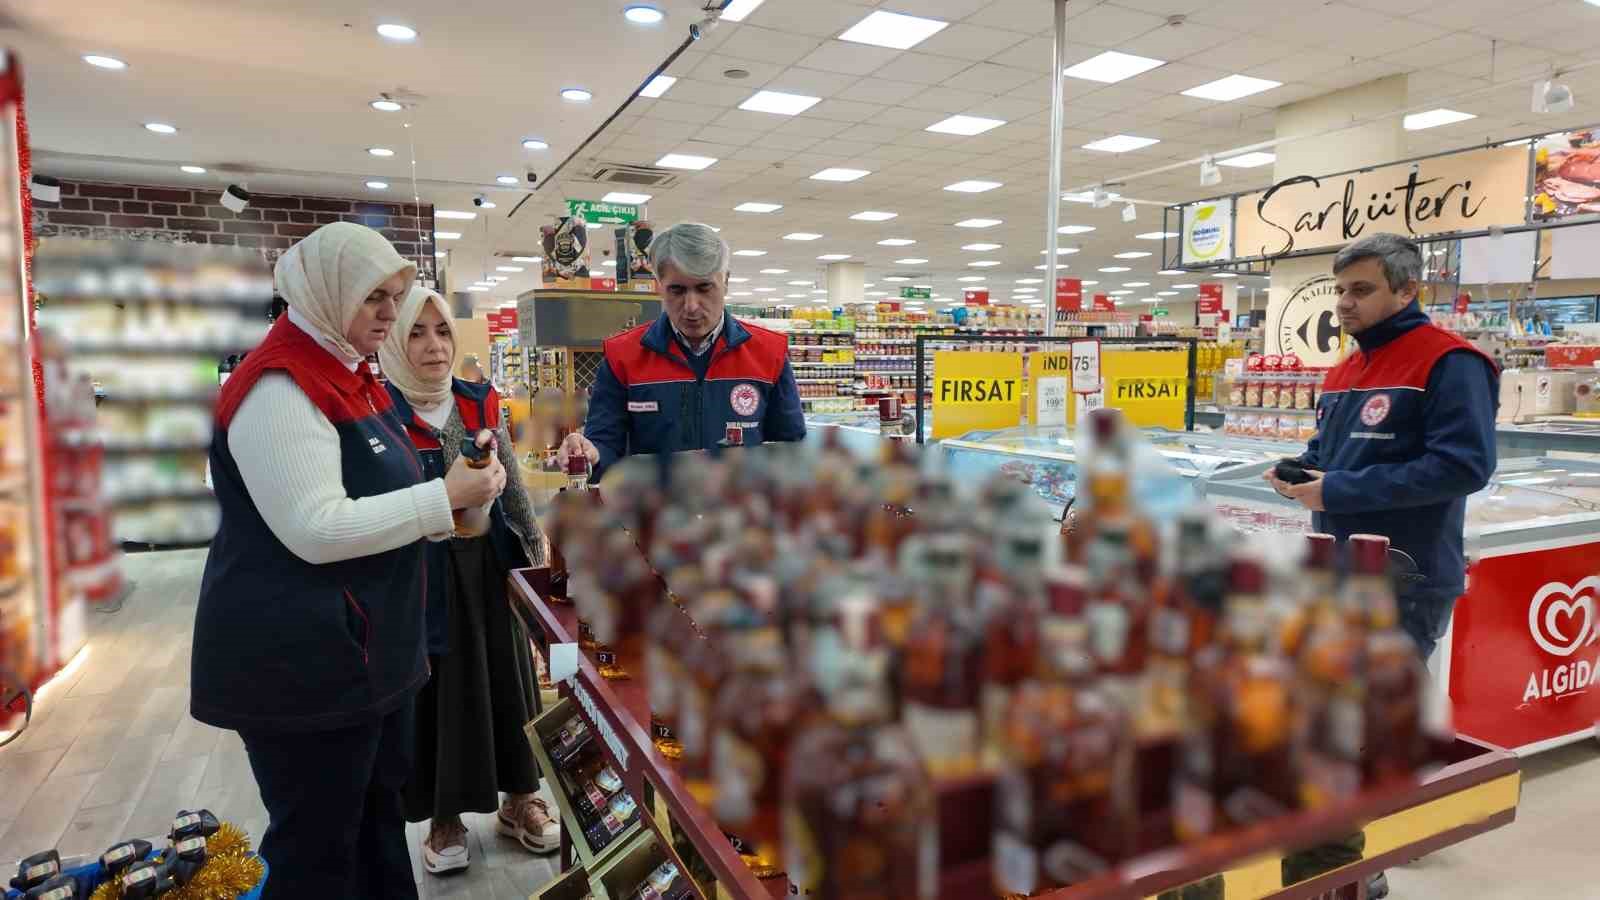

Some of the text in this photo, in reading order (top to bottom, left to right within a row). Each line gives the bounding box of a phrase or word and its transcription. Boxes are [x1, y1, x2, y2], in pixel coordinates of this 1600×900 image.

[941, 379, 1016, 402] FIRSAT
[660, 727, 671, 737] 12
[730, 838, 743, 852] 12
